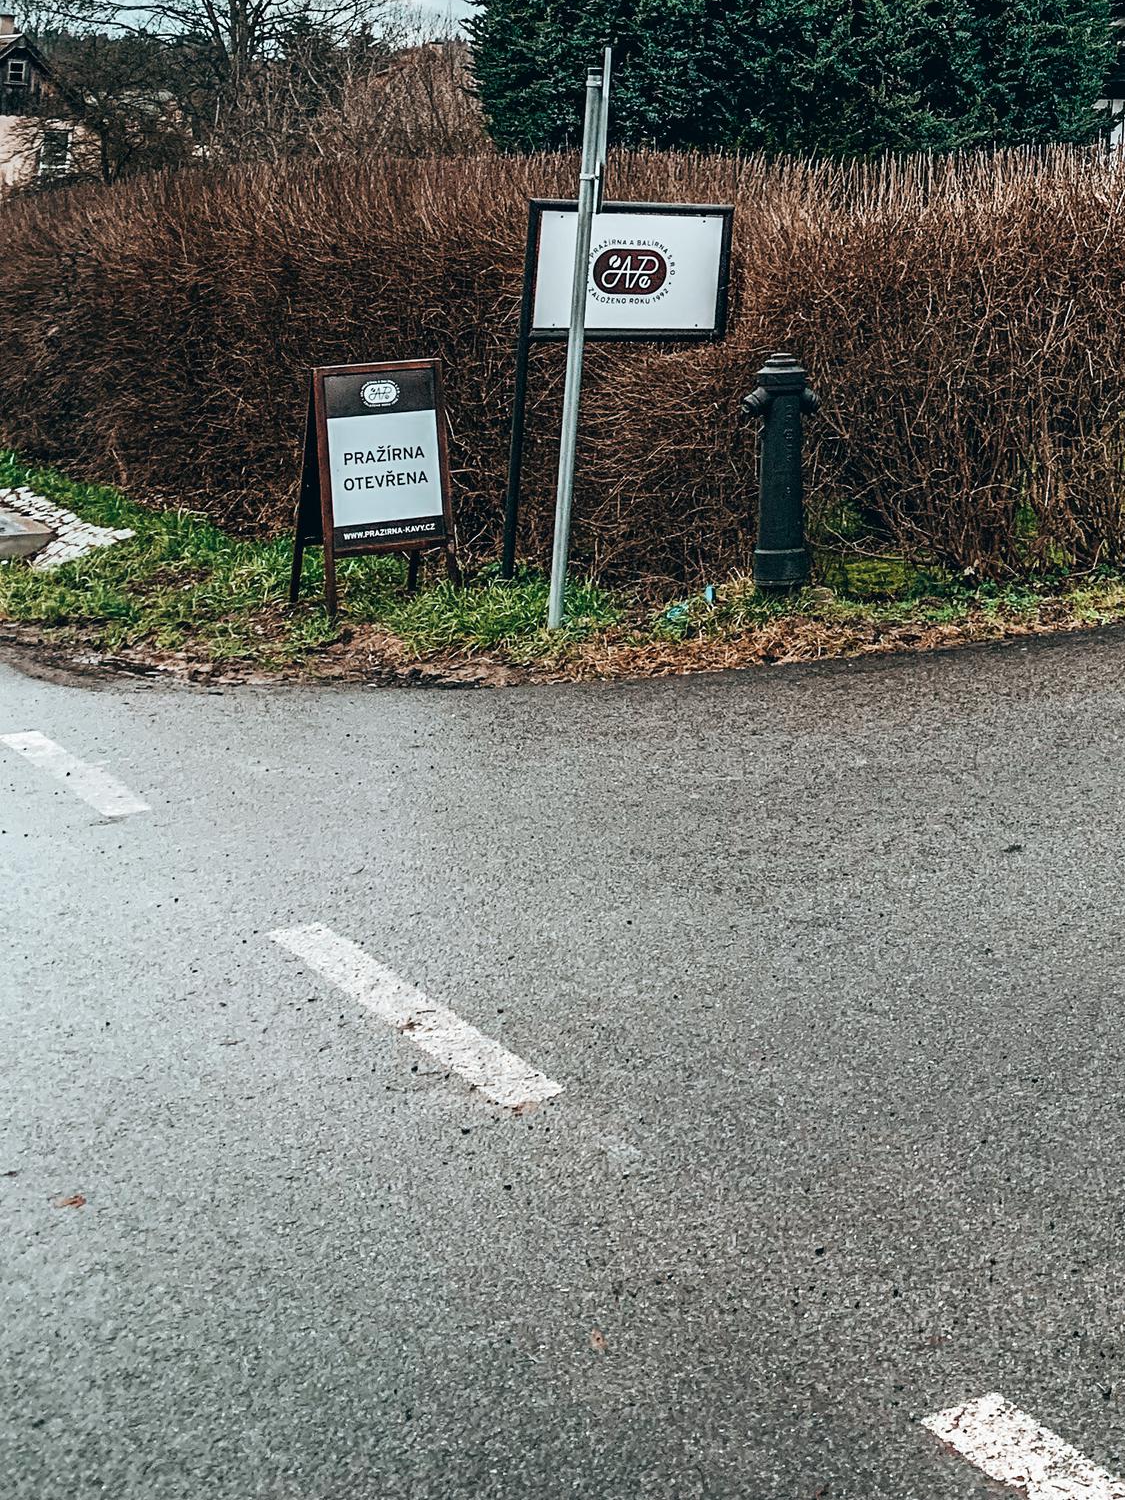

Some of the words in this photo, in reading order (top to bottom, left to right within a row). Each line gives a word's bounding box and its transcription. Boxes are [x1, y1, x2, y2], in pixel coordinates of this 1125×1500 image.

[652, 288, 669, 302] 1992
[344, 445, 425, 466] PRAŽÍRNA
[344, 470, 429, 491] OTEVŘENA
